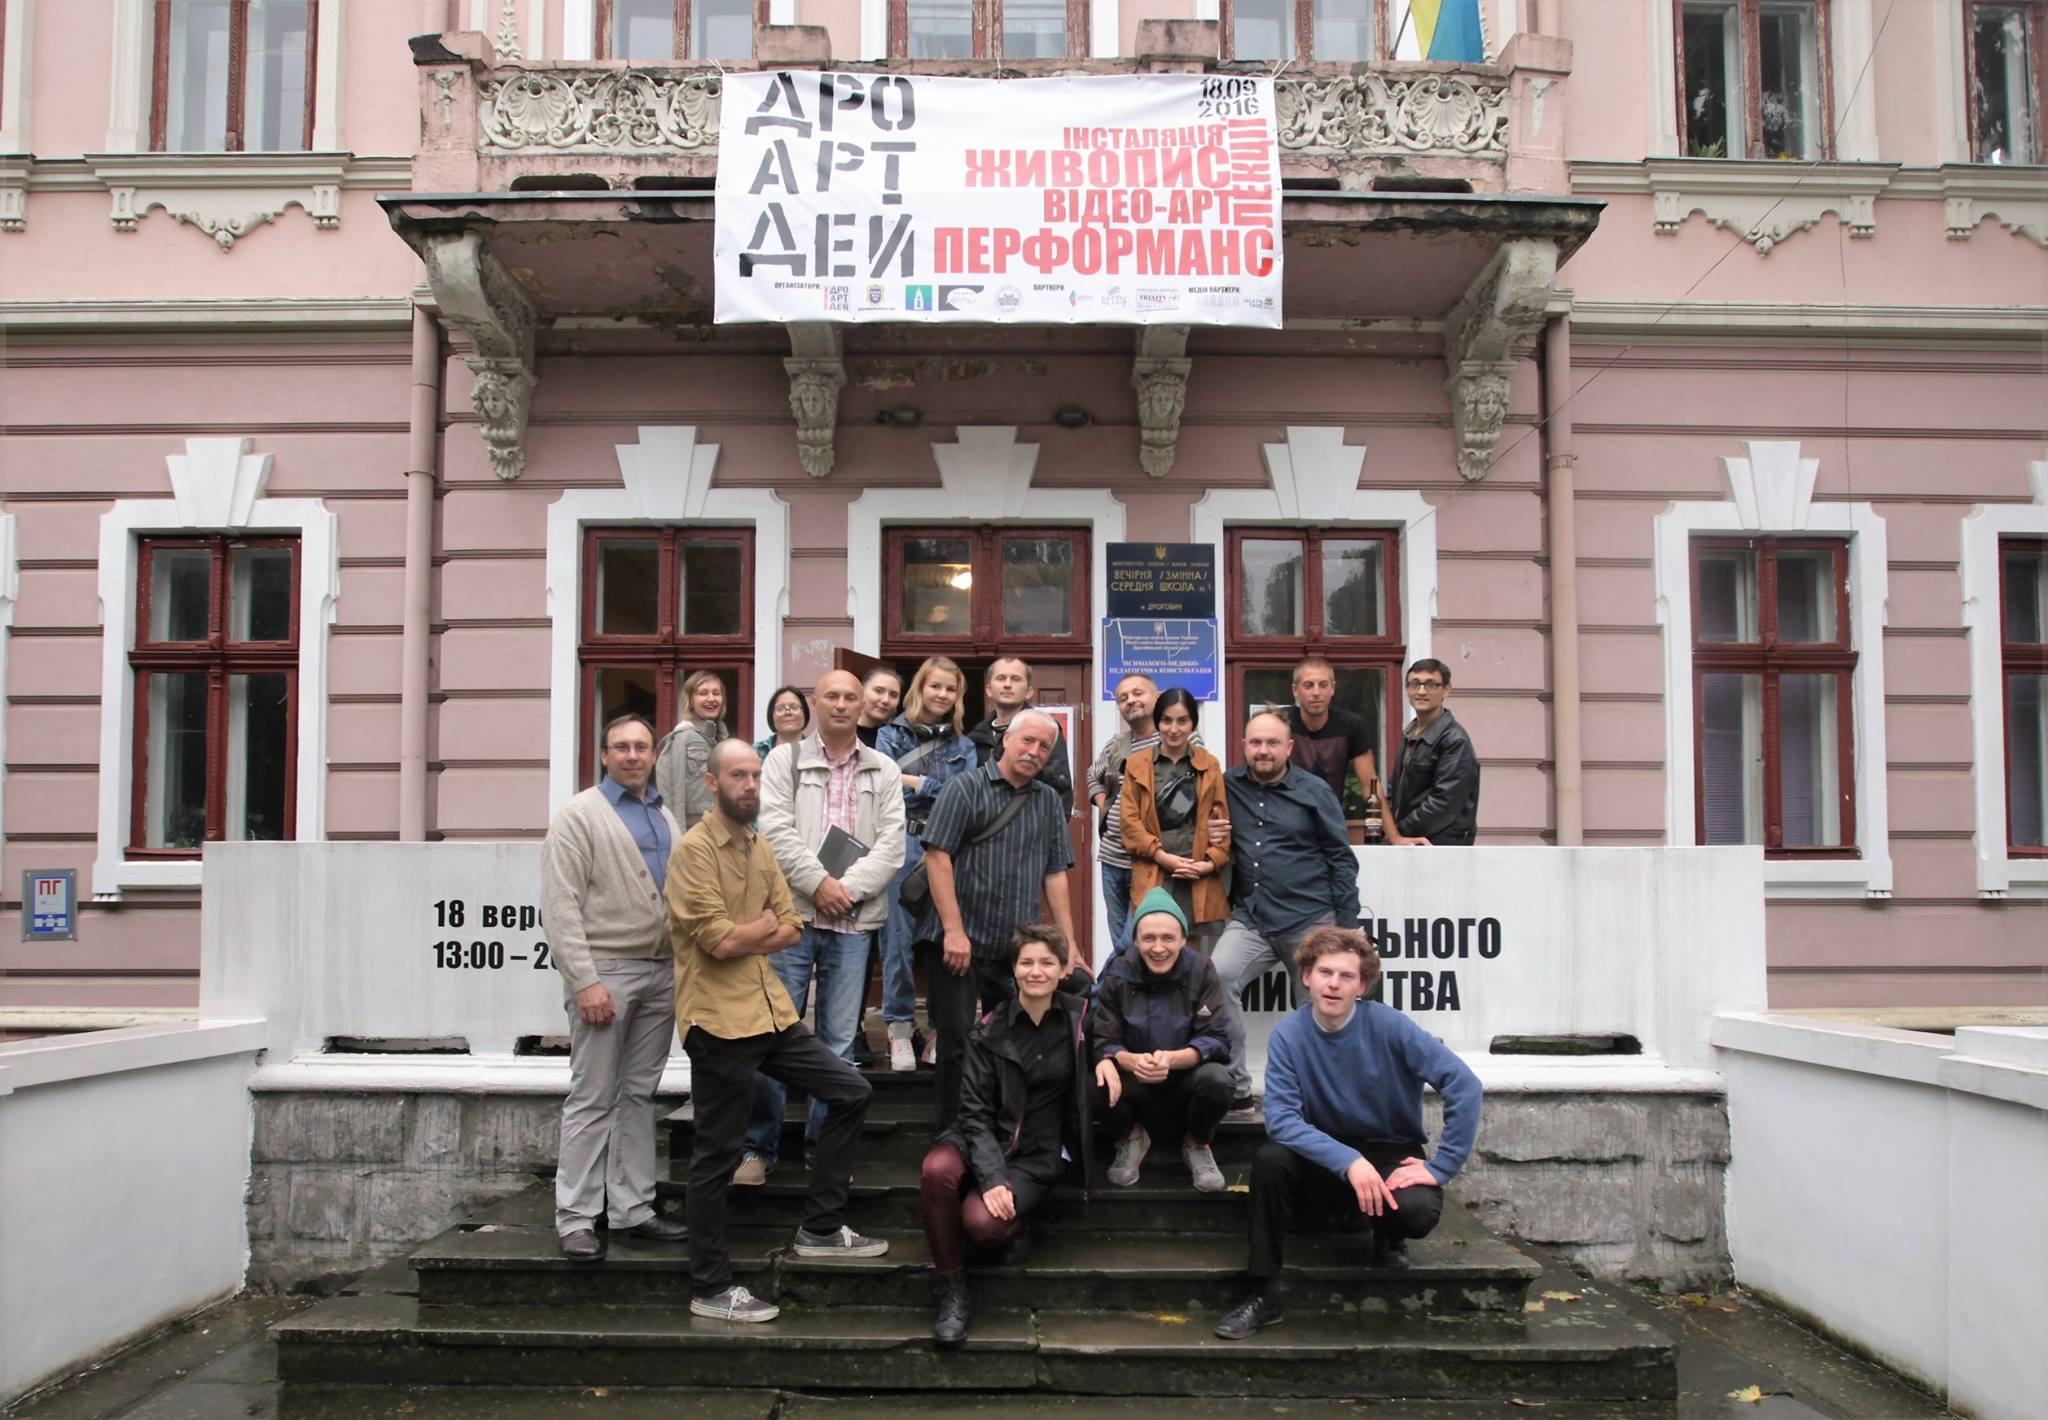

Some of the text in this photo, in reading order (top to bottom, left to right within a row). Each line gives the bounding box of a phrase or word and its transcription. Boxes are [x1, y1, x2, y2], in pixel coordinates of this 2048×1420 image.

[1200, 77, 1256, 99] 18.09
[745, 72, 916, 138] ДРО
[1198, 97, 1260, 118] 2016
[1063, 124, 1227, 149] ІНСТАЛЯЦІЯ
[748, 138, 916, 205] АРТ
[965, 146, 1231, 188] ЖИВОПИС
[1043, 188, 1234, 228] ВІДЕО-АРТ
[933, 226, 1274, 277] ПЕРФОРМАНС
[1111, 581, 1154, 592] СЕРЕДНЯ
[1160, 581, 1195, 592] ШКОЛА
[1114, 570, 1153, 580] ВЕЧІРНЯ
[39, 880, 62, 896] ПГ
[434, 899, 465, 928] 18
